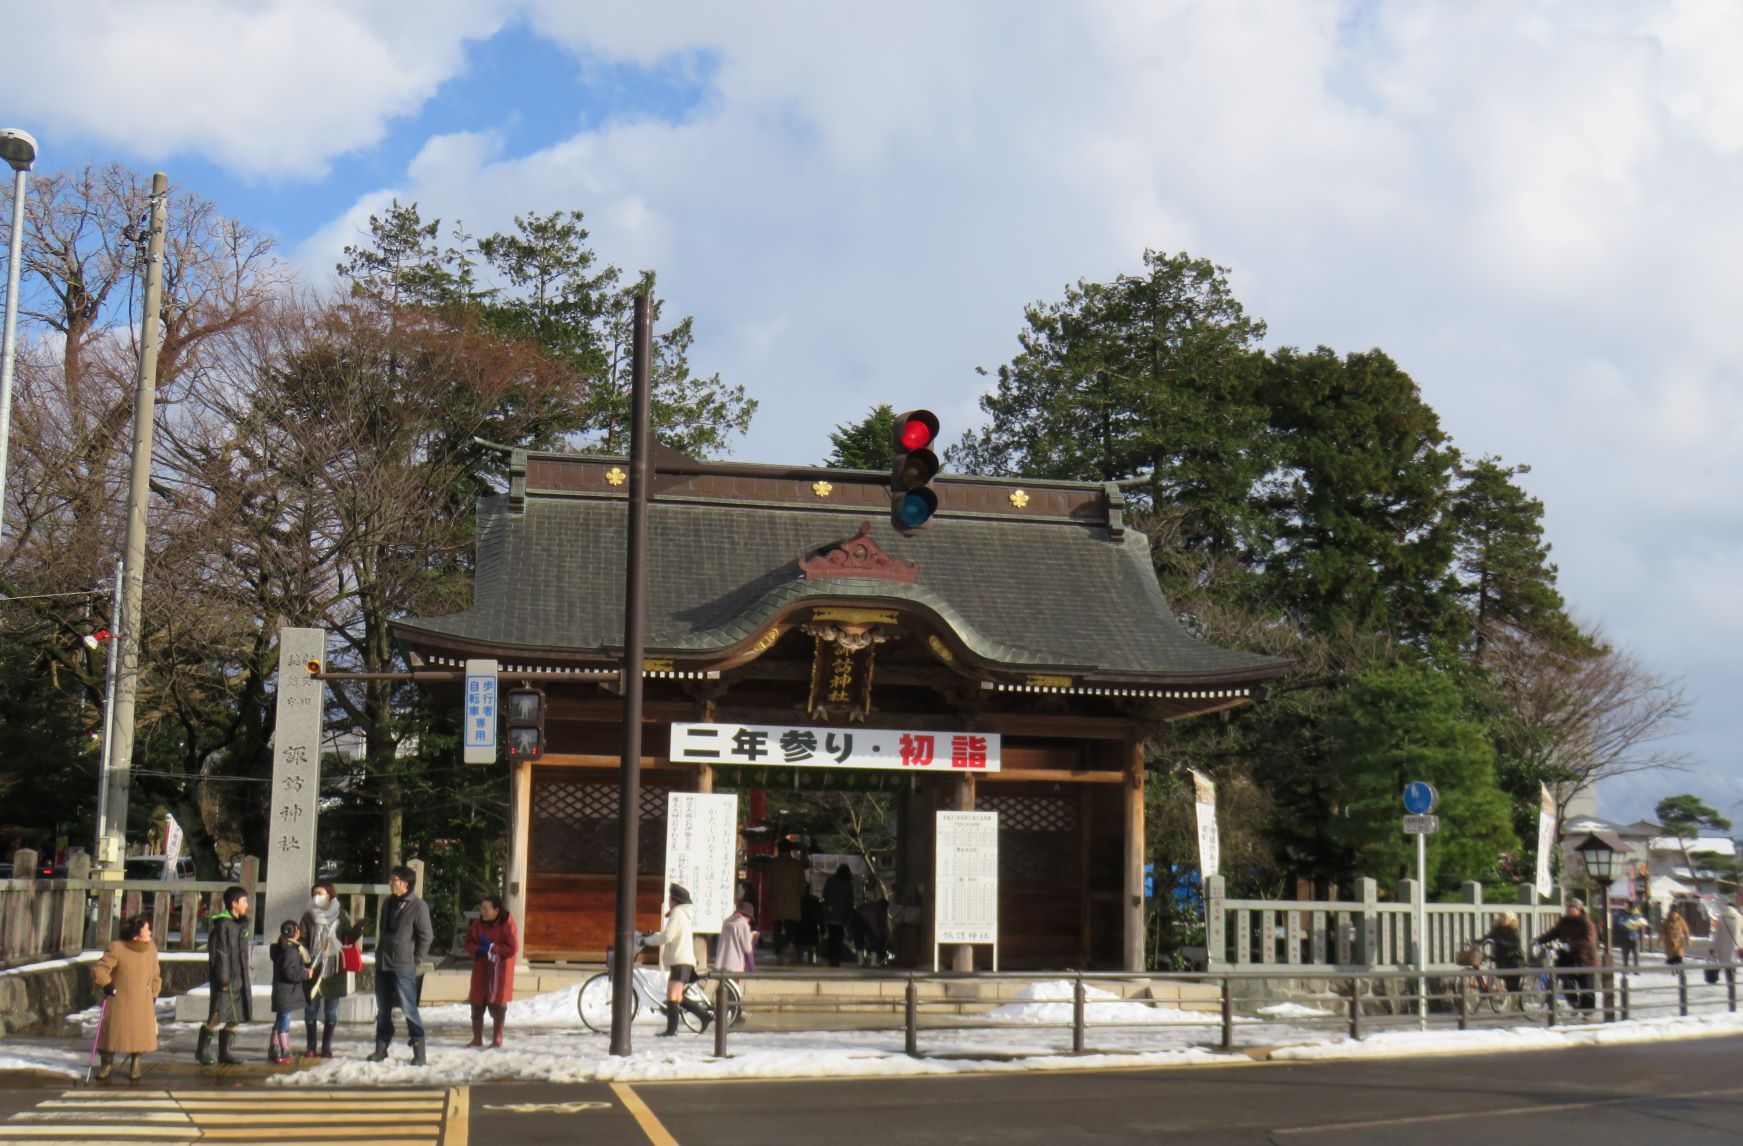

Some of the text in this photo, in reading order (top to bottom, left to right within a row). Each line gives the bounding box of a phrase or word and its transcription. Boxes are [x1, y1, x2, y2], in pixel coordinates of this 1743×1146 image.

[468, 680, 481, 717] 自転車
[482, 680, 495, 717] 歩行者
[475, 718, 487, 742] 専用
